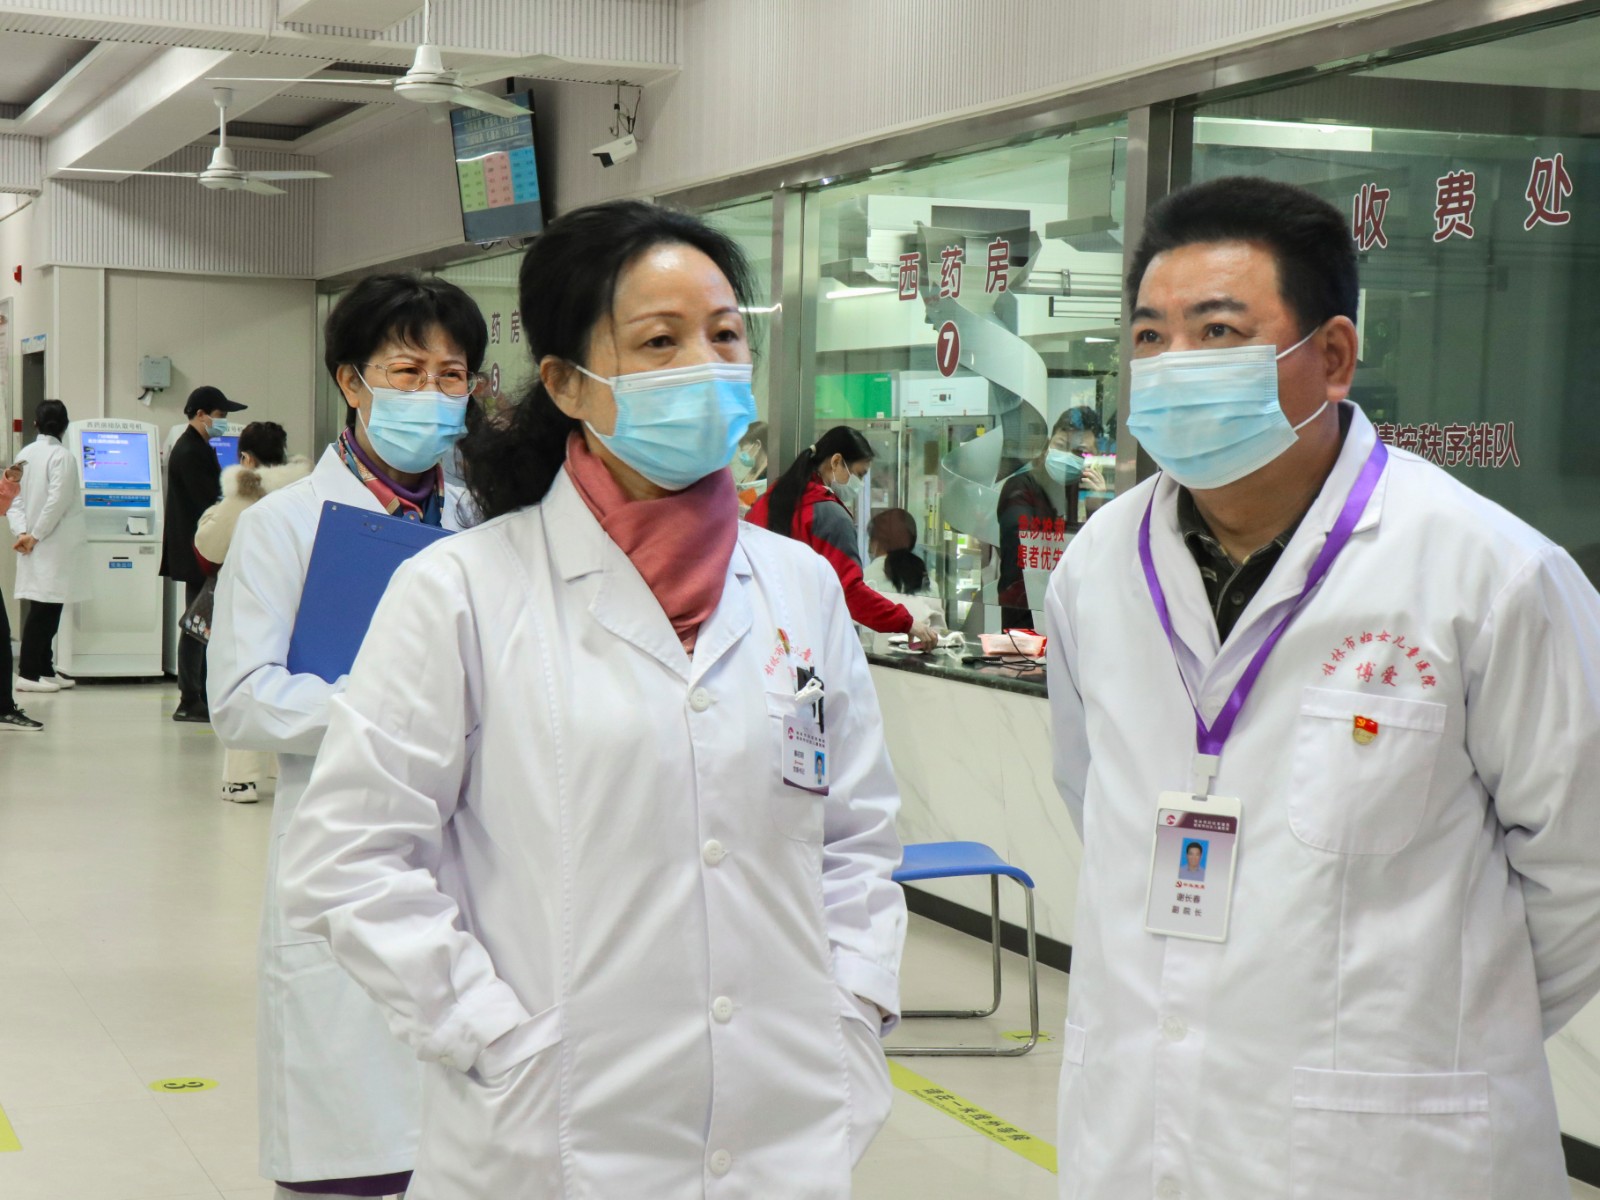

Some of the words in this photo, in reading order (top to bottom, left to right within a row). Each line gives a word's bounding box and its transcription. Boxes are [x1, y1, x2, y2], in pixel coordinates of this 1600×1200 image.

[1353, 153, 1573, 250] 收费处
[898, 237, 1010, 301] 西药房
[1017, 514, 1066, 542] 急诊抢救
[1017, 544, 1065, 571] 患者优先
